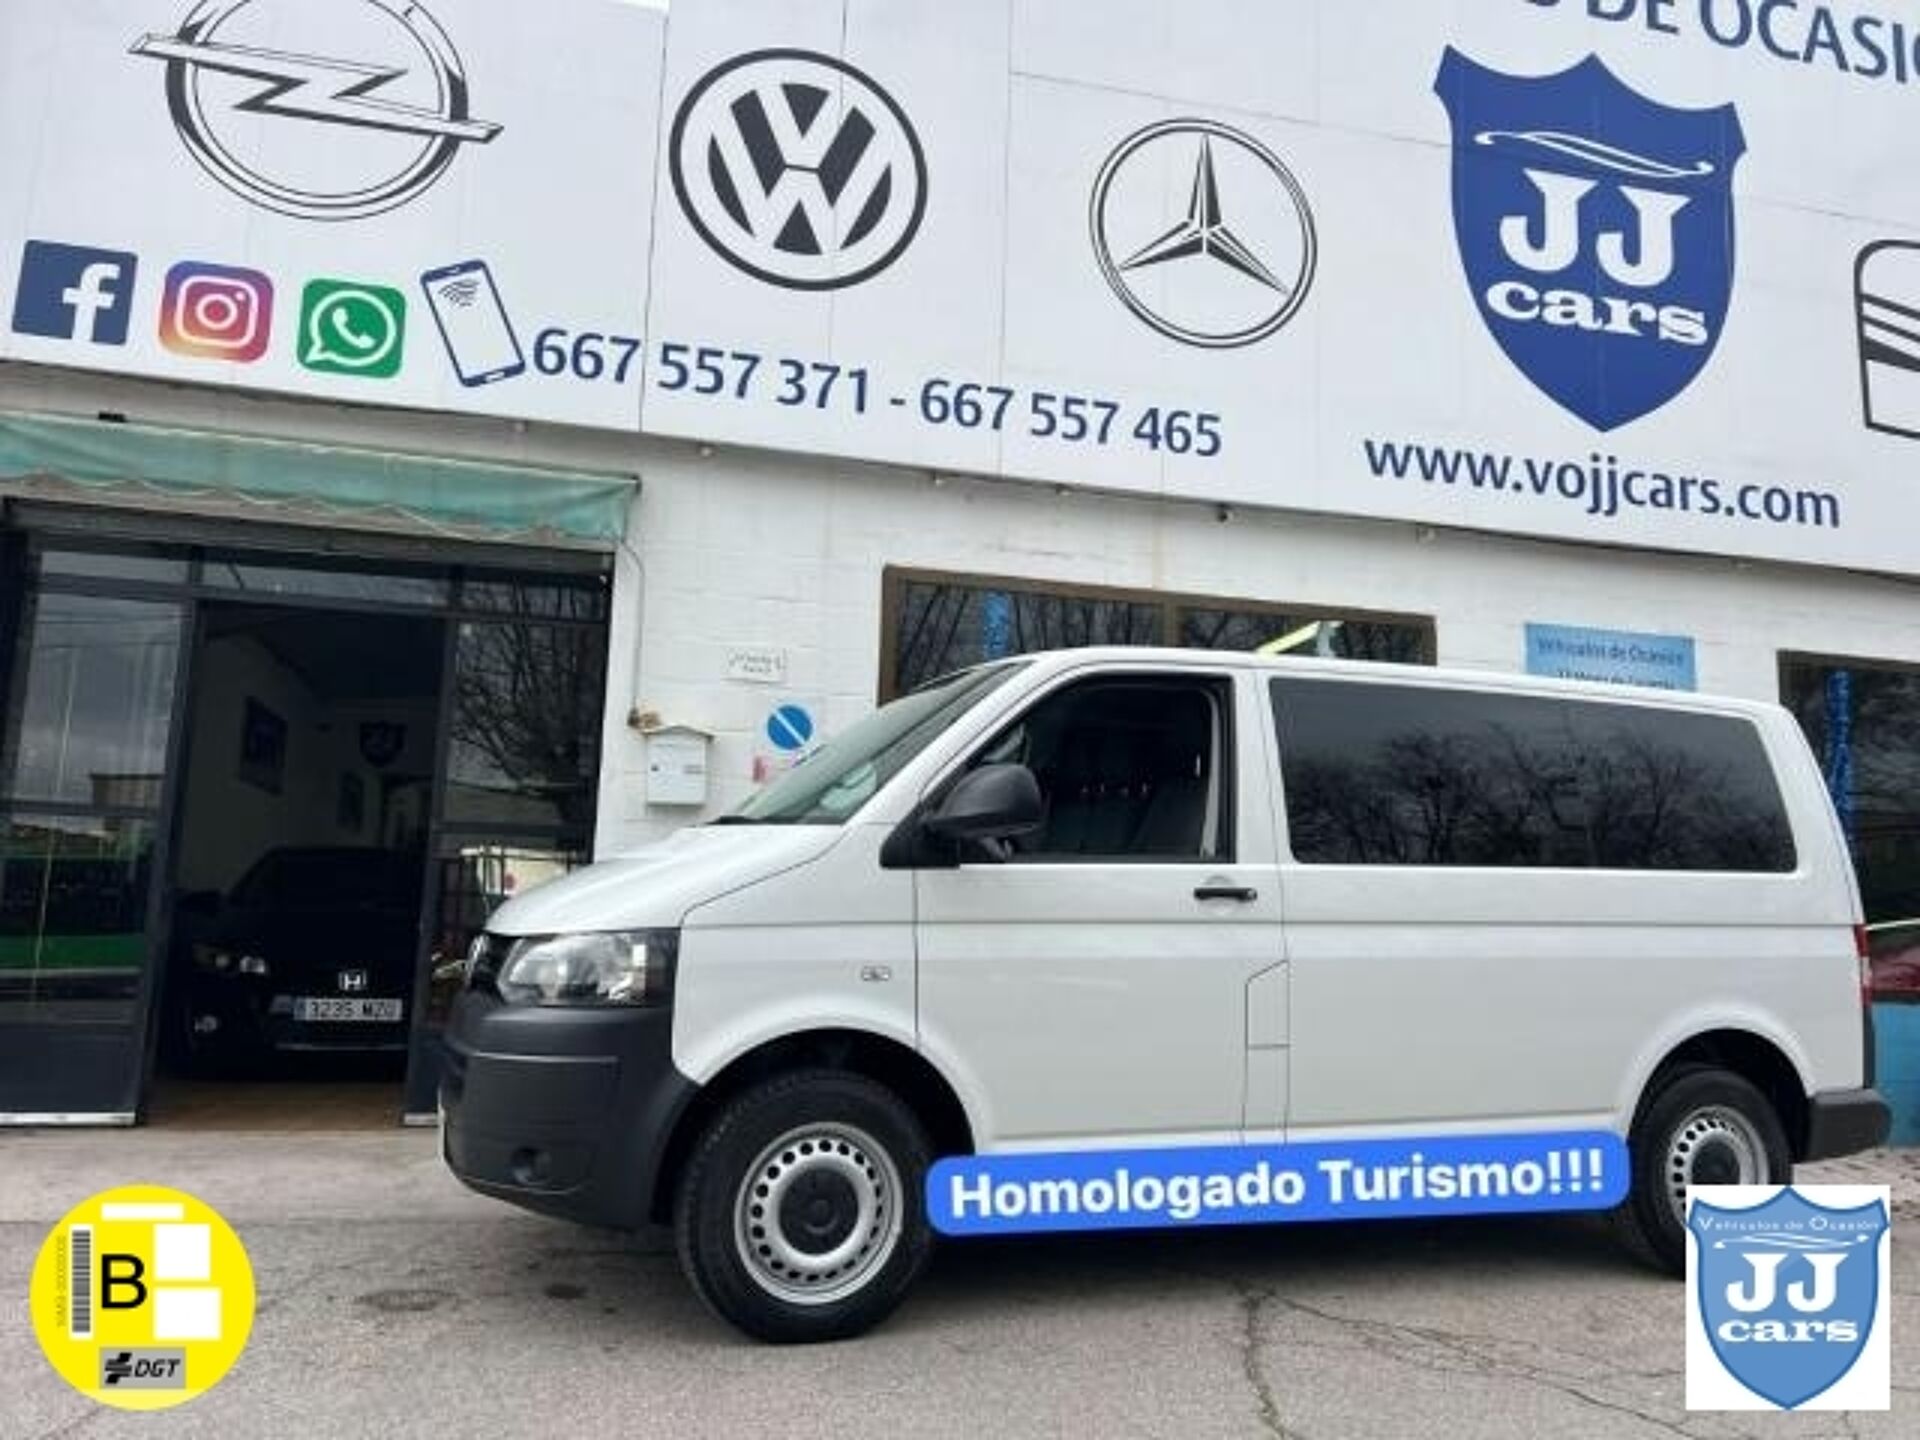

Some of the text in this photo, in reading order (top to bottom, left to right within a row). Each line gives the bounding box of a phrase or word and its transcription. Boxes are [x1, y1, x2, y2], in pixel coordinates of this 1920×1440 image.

[1700, 0, 1920, 84] OCASI
[1499, 168, 1691, 287] JJ
[1487, 281, 1708, 346] cars
[534, 328, 639, 383] 667
[659, 343, 760, 398] 557
[777, 359, 867, 413] 371
[921, 379, 1014, 430] 667
[1031, 393, 1118, 444] 557
[1134, 407, 1221, 456] 465
[1364, 440, 1840, 528] www.vojjcars.com
